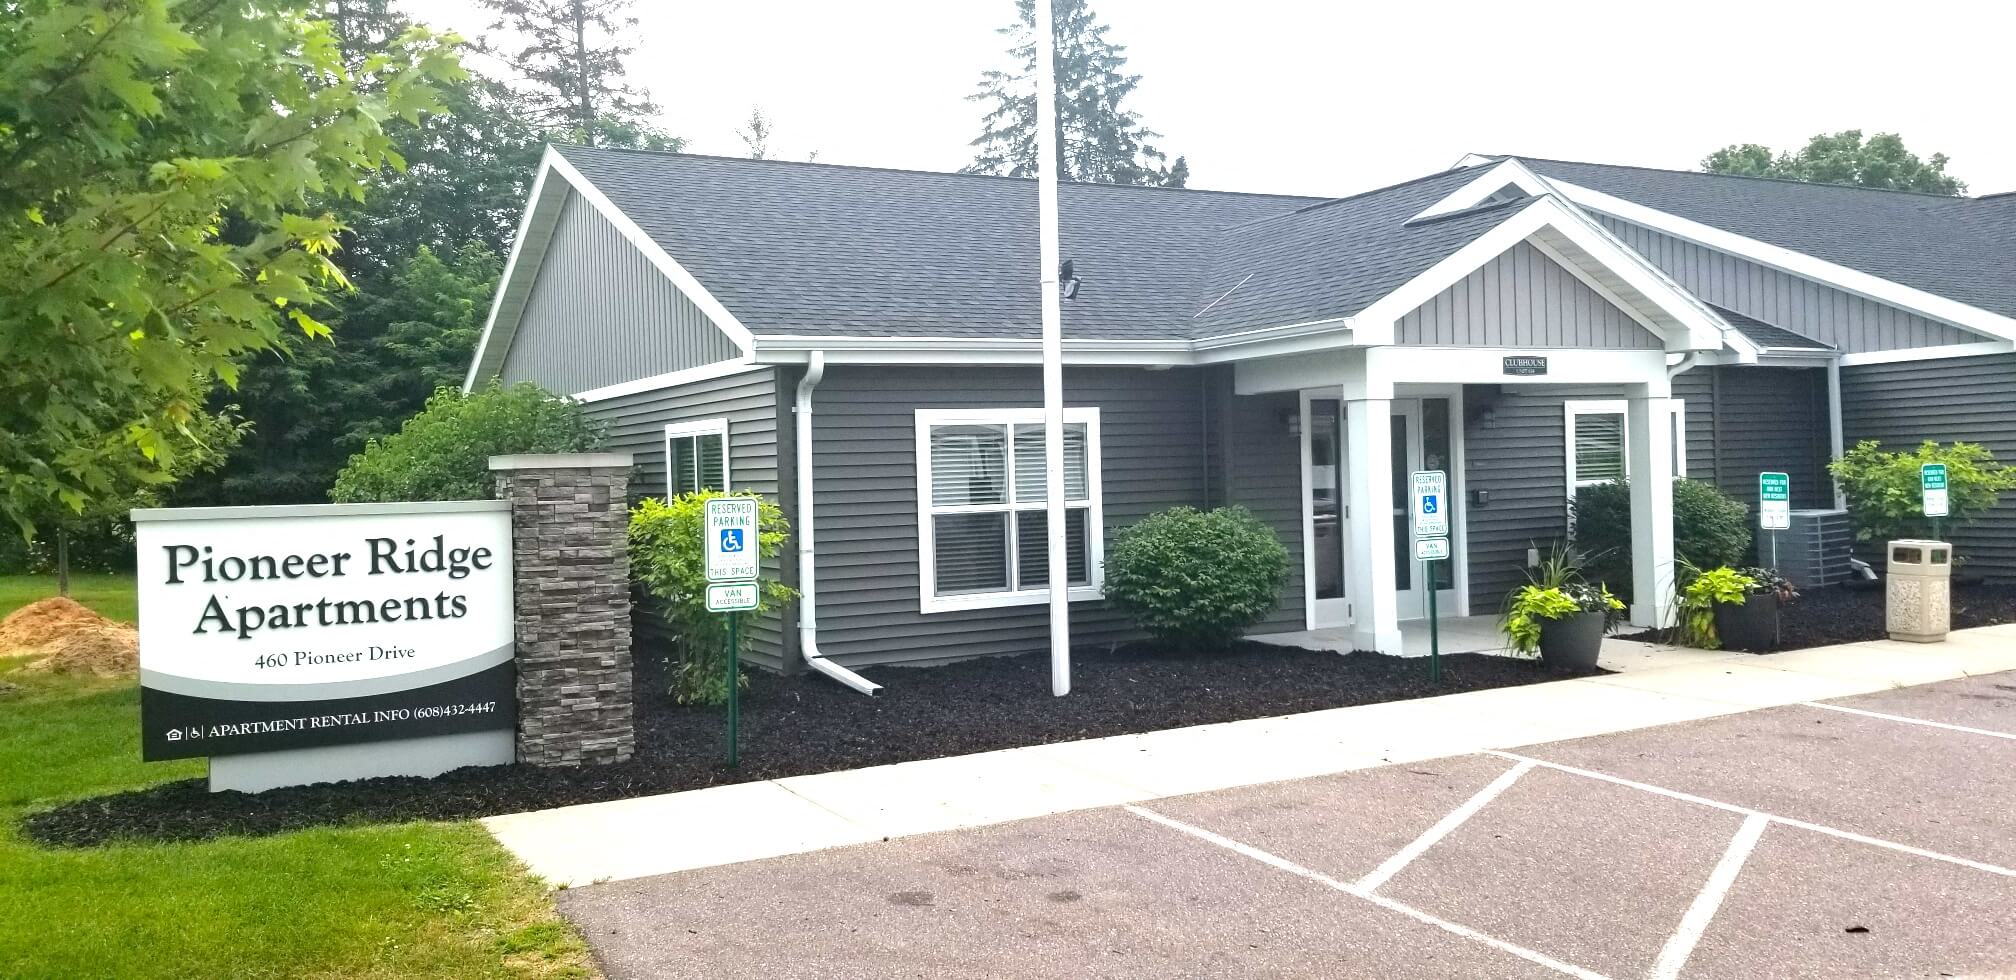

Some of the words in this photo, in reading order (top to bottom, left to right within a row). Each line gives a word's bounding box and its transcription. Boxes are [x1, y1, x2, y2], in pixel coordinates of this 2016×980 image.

[1504, 359, 1546, 368] CLUBHOUSE
[1416, 475, 1442, 484] RESERVED
[1417, 485, 1441, 494] PARKING
[711, 503, 752, 515] RESERVED
[713, 516, 750, 527] PARKING
[162, 544, 351, 584] Pioneer
[364, 534, 493, 579] Ridge
[710, 568, 727, 577] THIS
[731, 566, 754, 576] SPACE
[724, 589, 742, 598] VAN
[192, 591, 467, 640] Apartments
[254, 652, 288, 669] 460
[293, 650, 363, 666] Pioneer
[368, 645, 416, 661] Drive
[208, 718, 308, 738] APARTMENT
[310, 712, 371, 729] RENTAL
[374, 708, 410, 723] INFO
[413, 701, 497, 720] (608)432-4447
